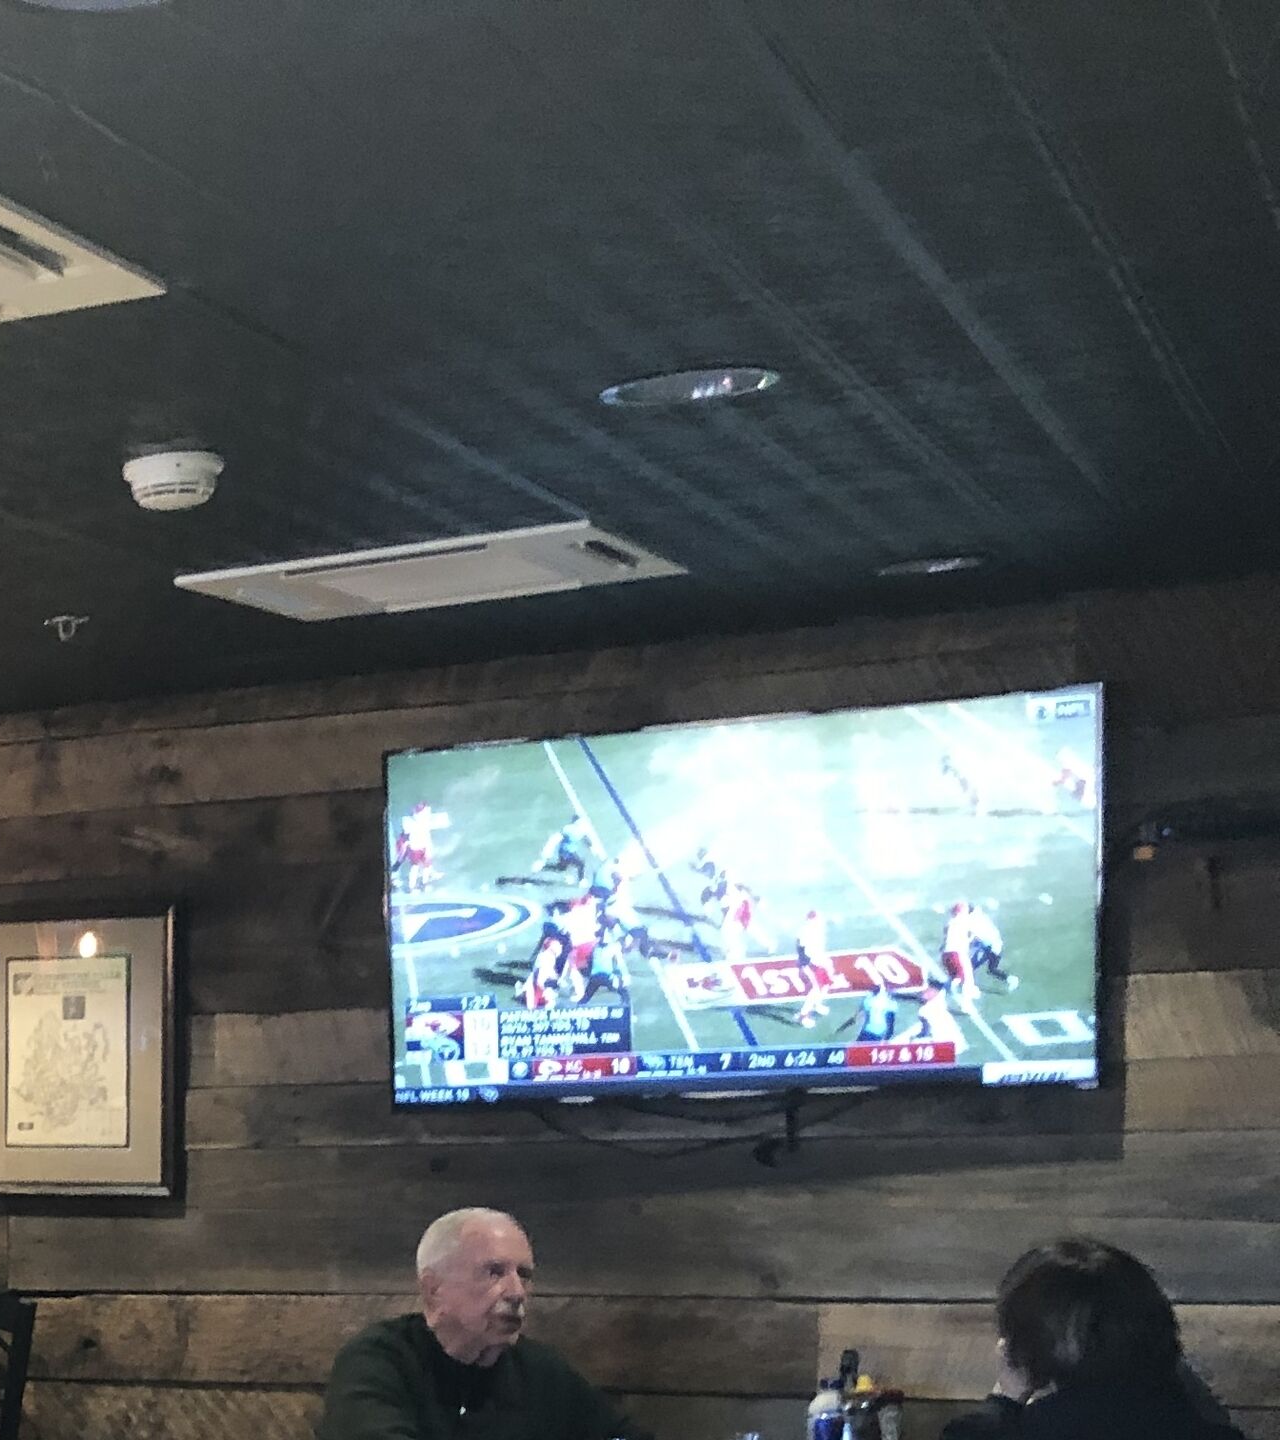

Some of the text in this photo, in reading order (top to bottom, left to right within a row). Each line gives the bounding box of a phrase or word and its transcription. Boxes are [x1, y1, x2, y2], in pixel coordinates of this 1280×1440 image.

[741, 964, 806, 996] 1ST
[854, 953, 911, 988] 10
[719, 1052, 732, 1072] 7
[869, 1048, 895, 1064] 1ST
